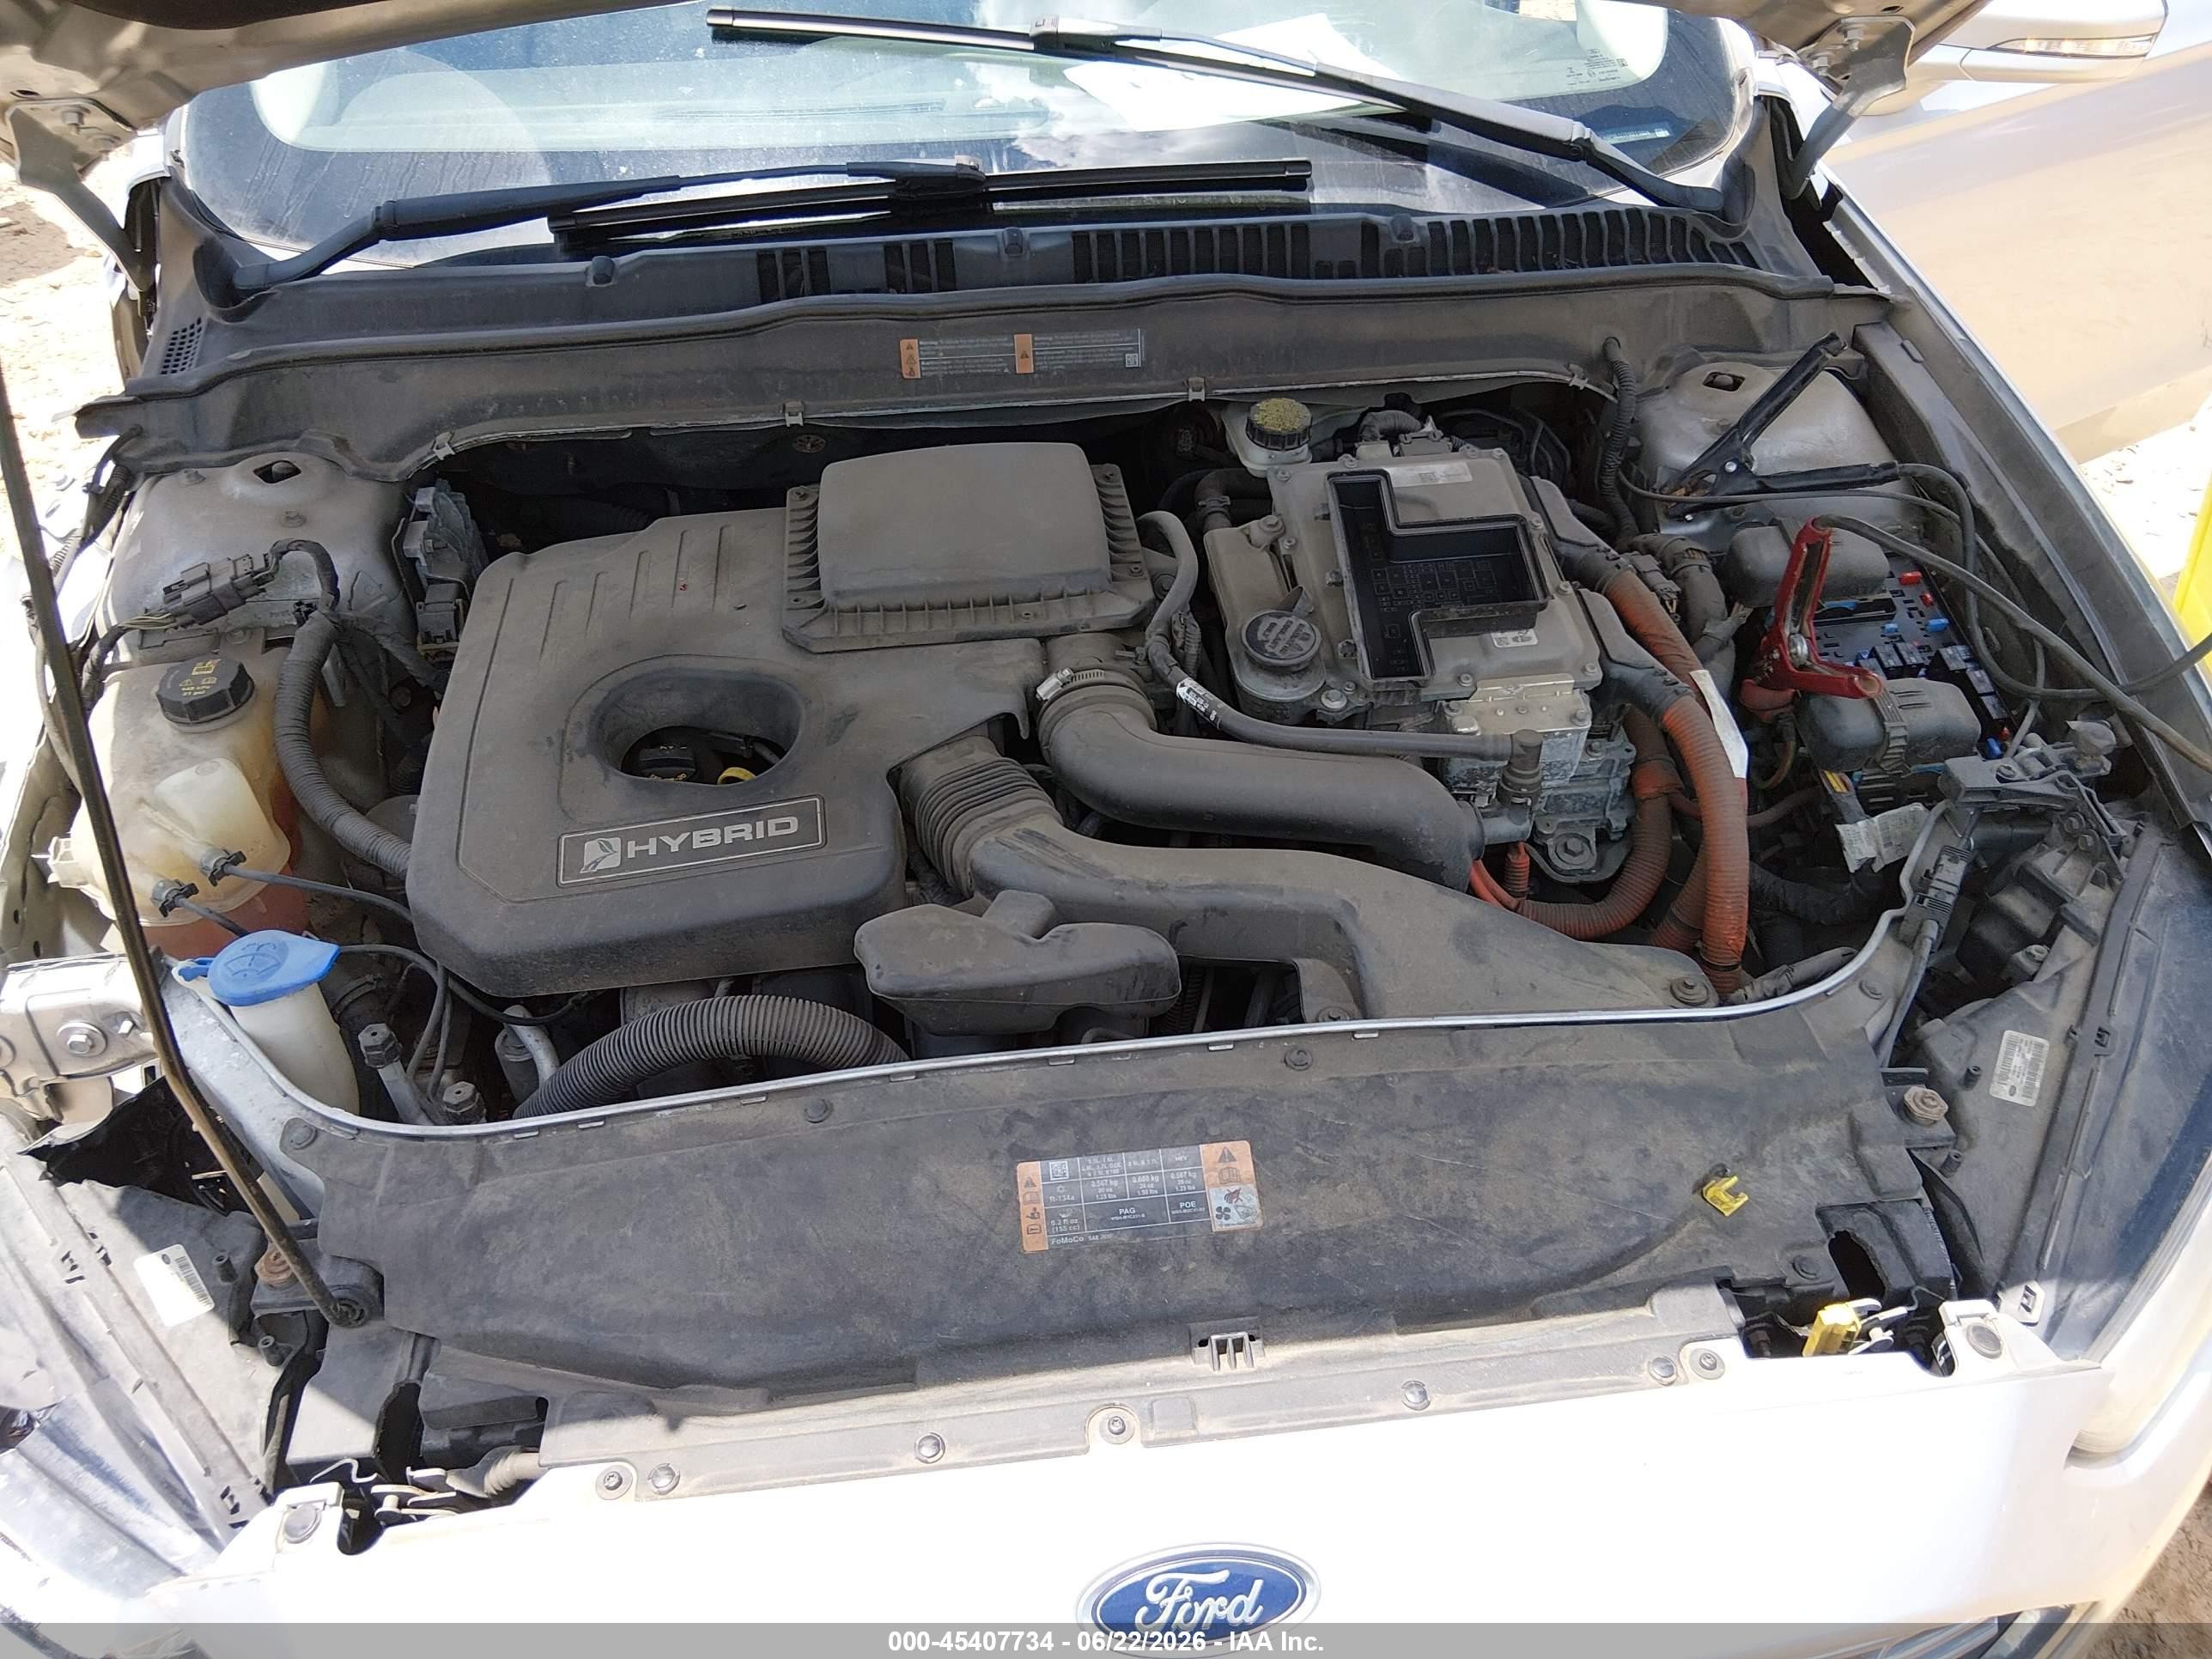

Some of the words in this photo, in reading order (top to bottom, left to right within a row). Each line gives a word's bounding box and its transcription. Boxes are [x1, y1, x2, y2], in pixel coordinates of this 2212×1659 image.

[627, 816, 799, 859] HYBRID
[1179, 1200, 1196, 1209] POE
[1051, 1237, 1085, 1245] FoMoCo
[1134, 1569, 1264, 1633] Ford
